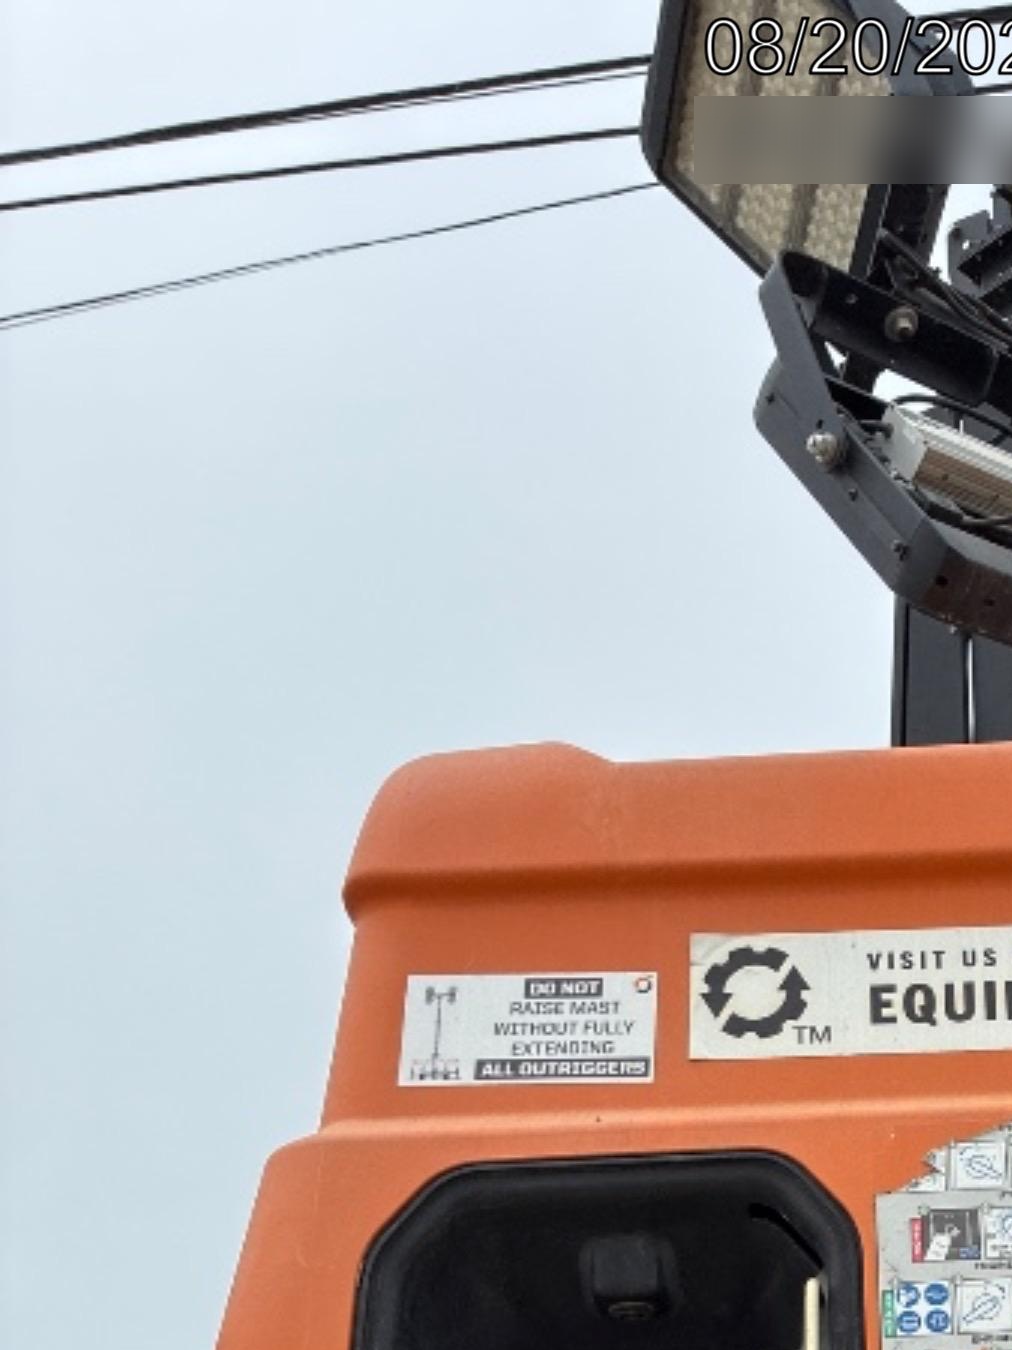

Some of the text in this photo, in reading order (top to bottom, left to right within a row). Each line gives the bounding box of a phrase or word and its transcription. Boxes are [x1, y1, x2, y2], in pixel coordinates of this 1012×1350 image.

[867, 950, 946, 971] VISIT
[962, 948, 997, 967] US
[530, 981, 599, 996] DO NOT
[509, 1001, 621, 1015] RAISE MAST
[494, 1020, 635, 1036] WITHOUT FULLY
[792, 1026, 832, 1045] TM
[511, 1040, 615, 1056] EXTENDING
[481, 1060, 647, 1077] ALL OUTRIGGERS
